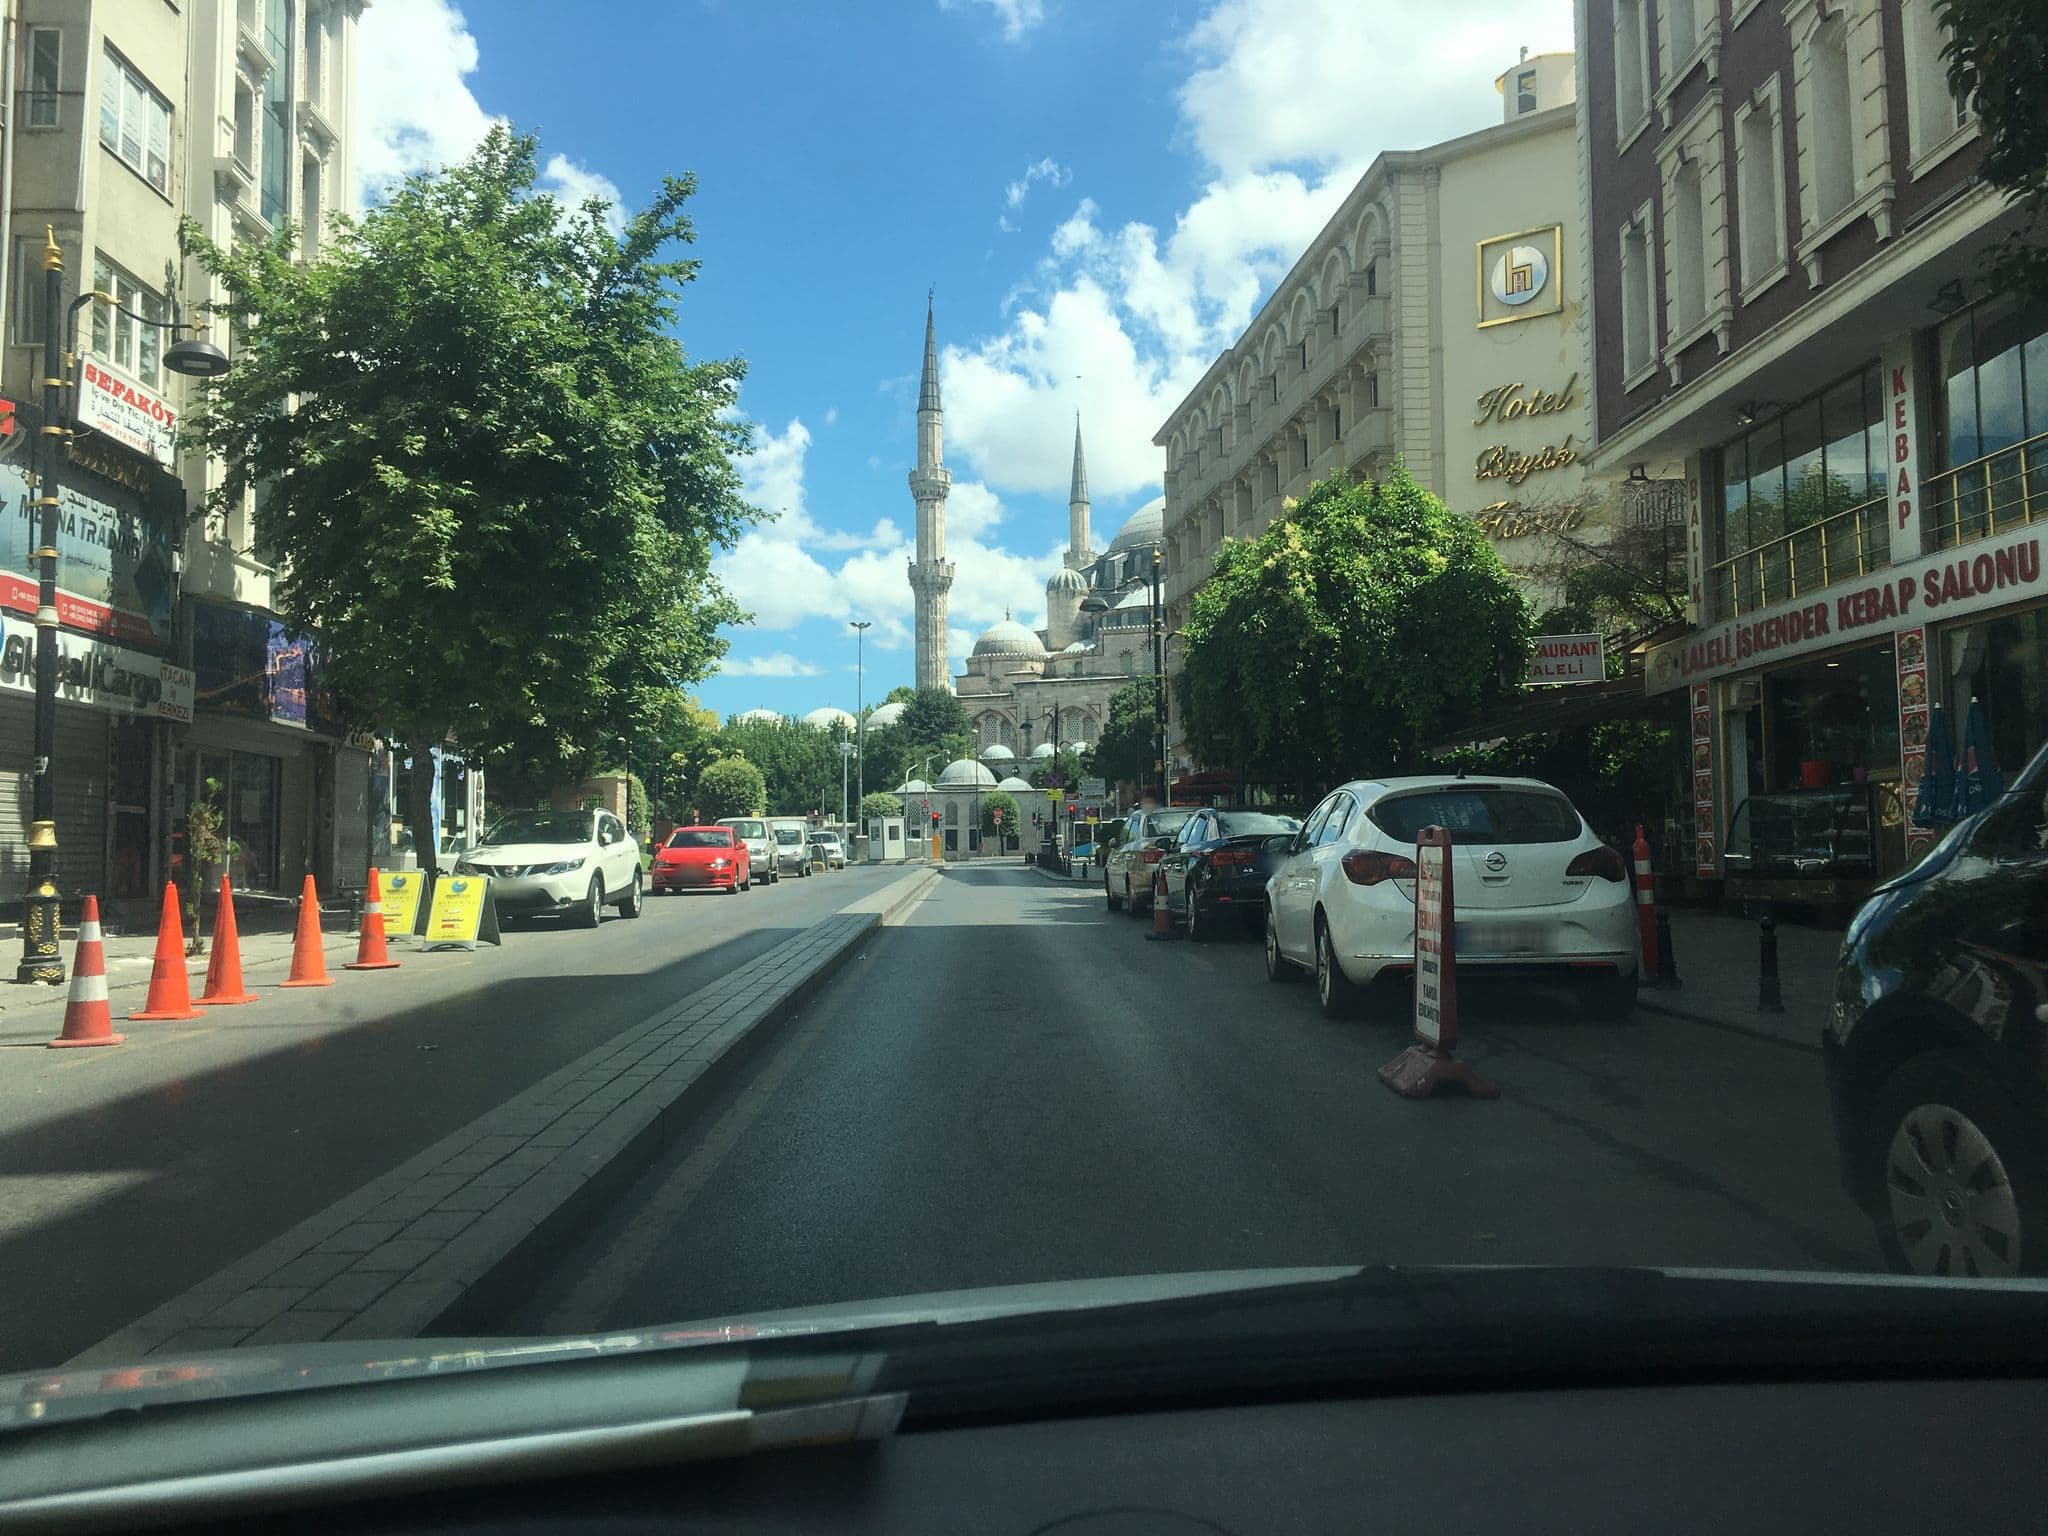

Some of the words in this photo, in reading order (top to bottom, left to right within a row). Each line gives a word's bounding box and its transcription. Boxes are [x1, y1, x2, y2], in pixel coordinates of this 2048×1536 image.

[85, 363, 176, 428] SEFAKÖY
[1472, 371, 1578, 426] Hotel
[1474, 434, 1579, 486] Büyük
[1891, 366, 1911, 530] KEBAP
[1689, 478, 1700, 604] BALIK
[1679, 628, 1732, 678] LALELİ
[1735, 602, 1830, 660] İSKENDER
[1837, 577, 1916, 632] KEBAP
[1923, 539, 2040, 608] SALONU
[3, 634, 99, 689] Glbal
[1533, 658, 1583, 676] ALELİ
